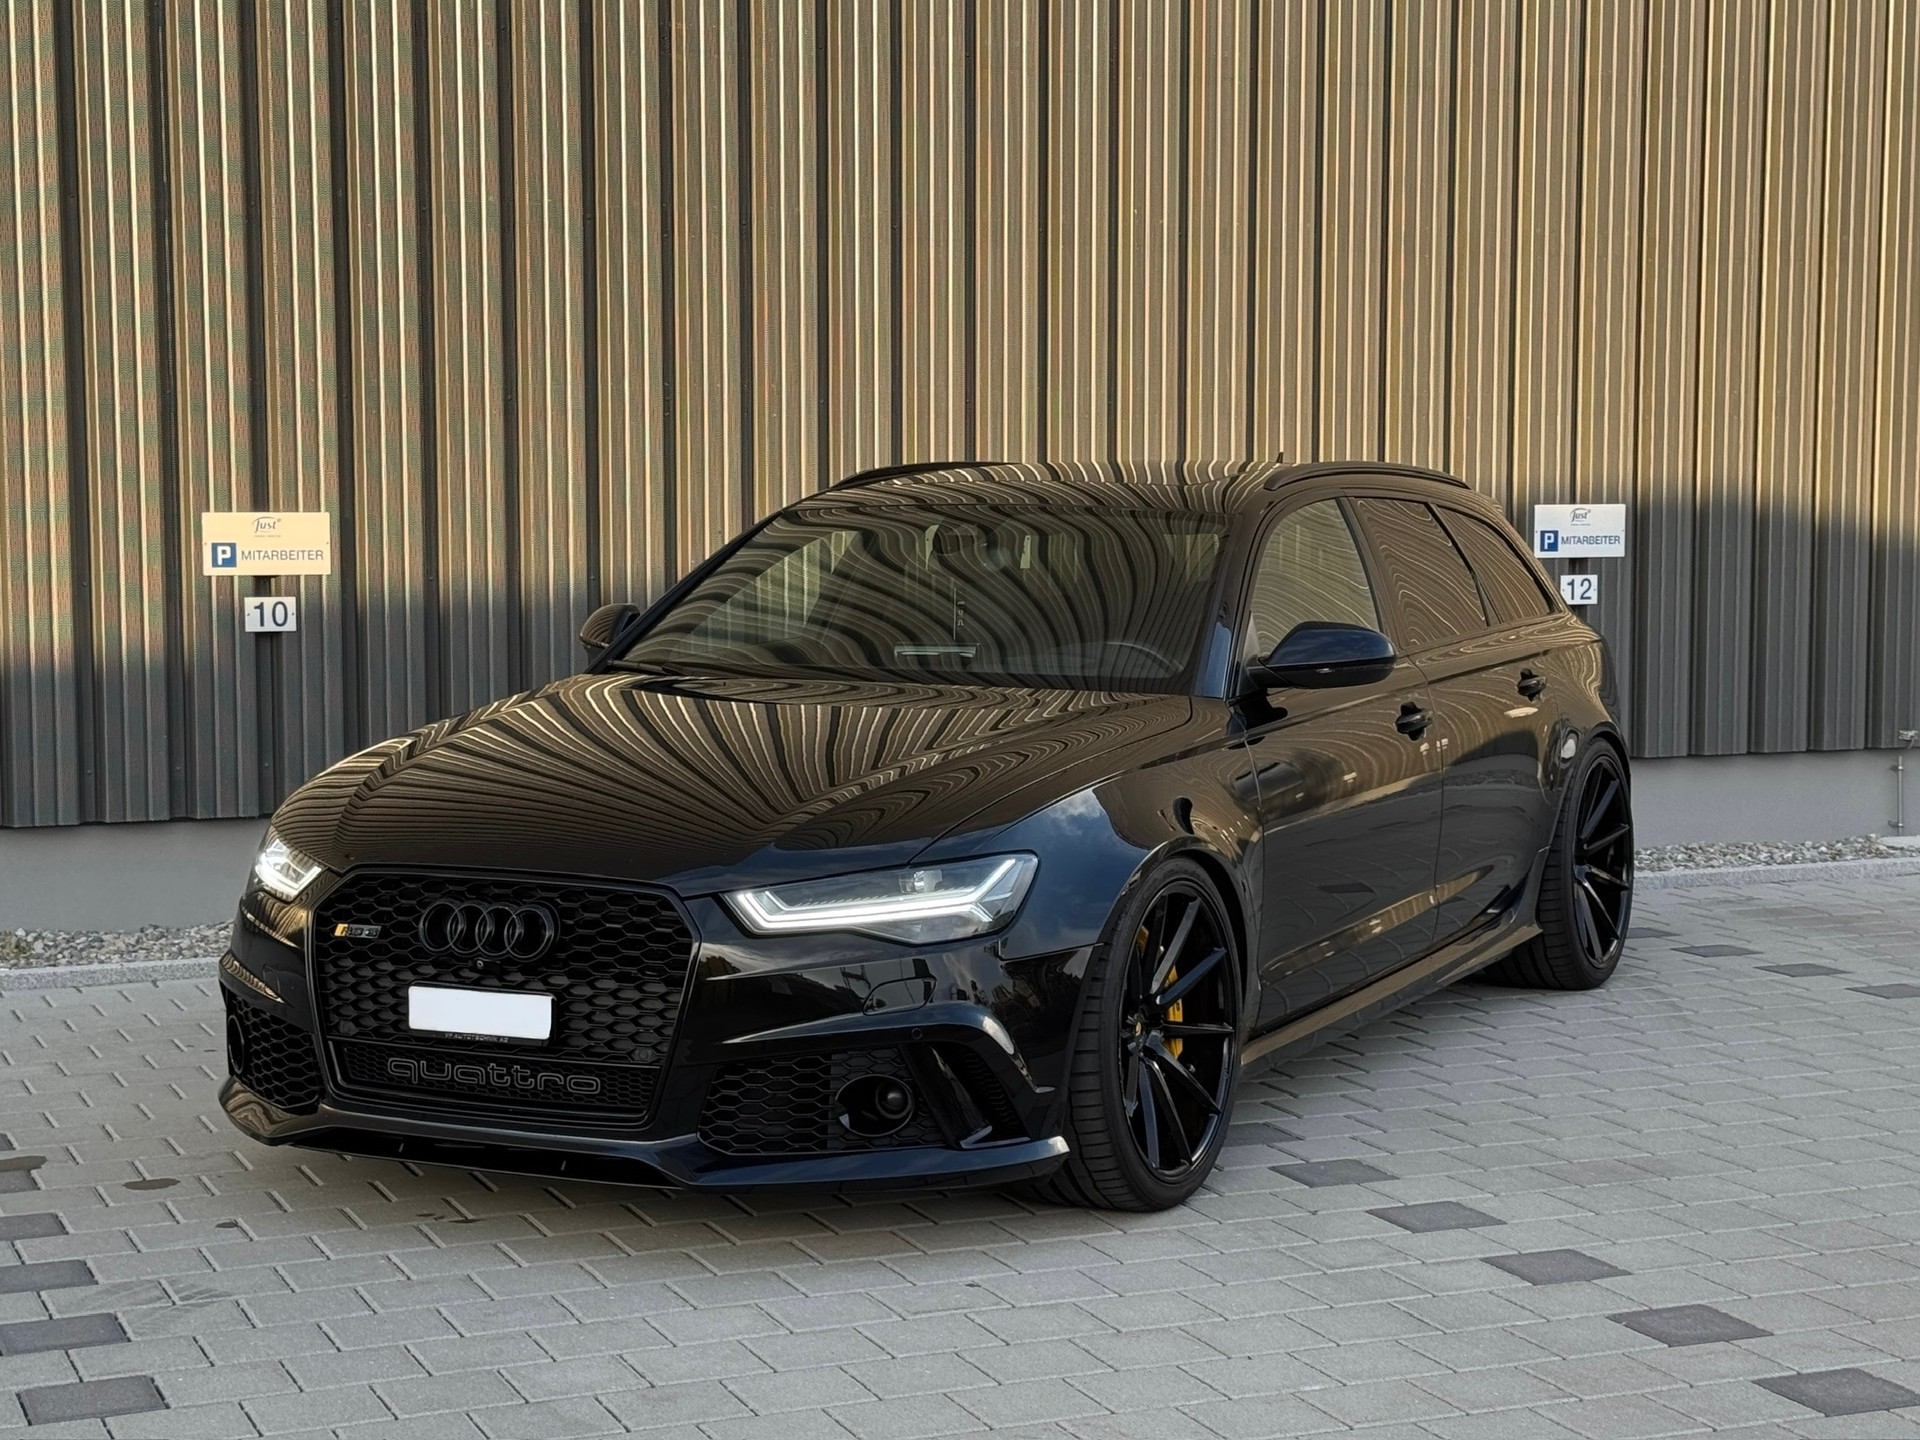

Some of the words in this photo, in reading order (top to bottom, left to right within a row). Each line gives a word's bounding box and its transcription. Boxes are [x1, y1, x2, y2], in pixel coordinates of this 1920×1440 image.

[1560, 535, 1621, 545] MITARBEITER
[217, 545, 232, 566] P
[241, 549, 324, 561] MITARBEITER
[1567, 578, 1592, 601] 12
[253, 601, 289, 628] 10
[387, 1057, 601, 1095] quattro
